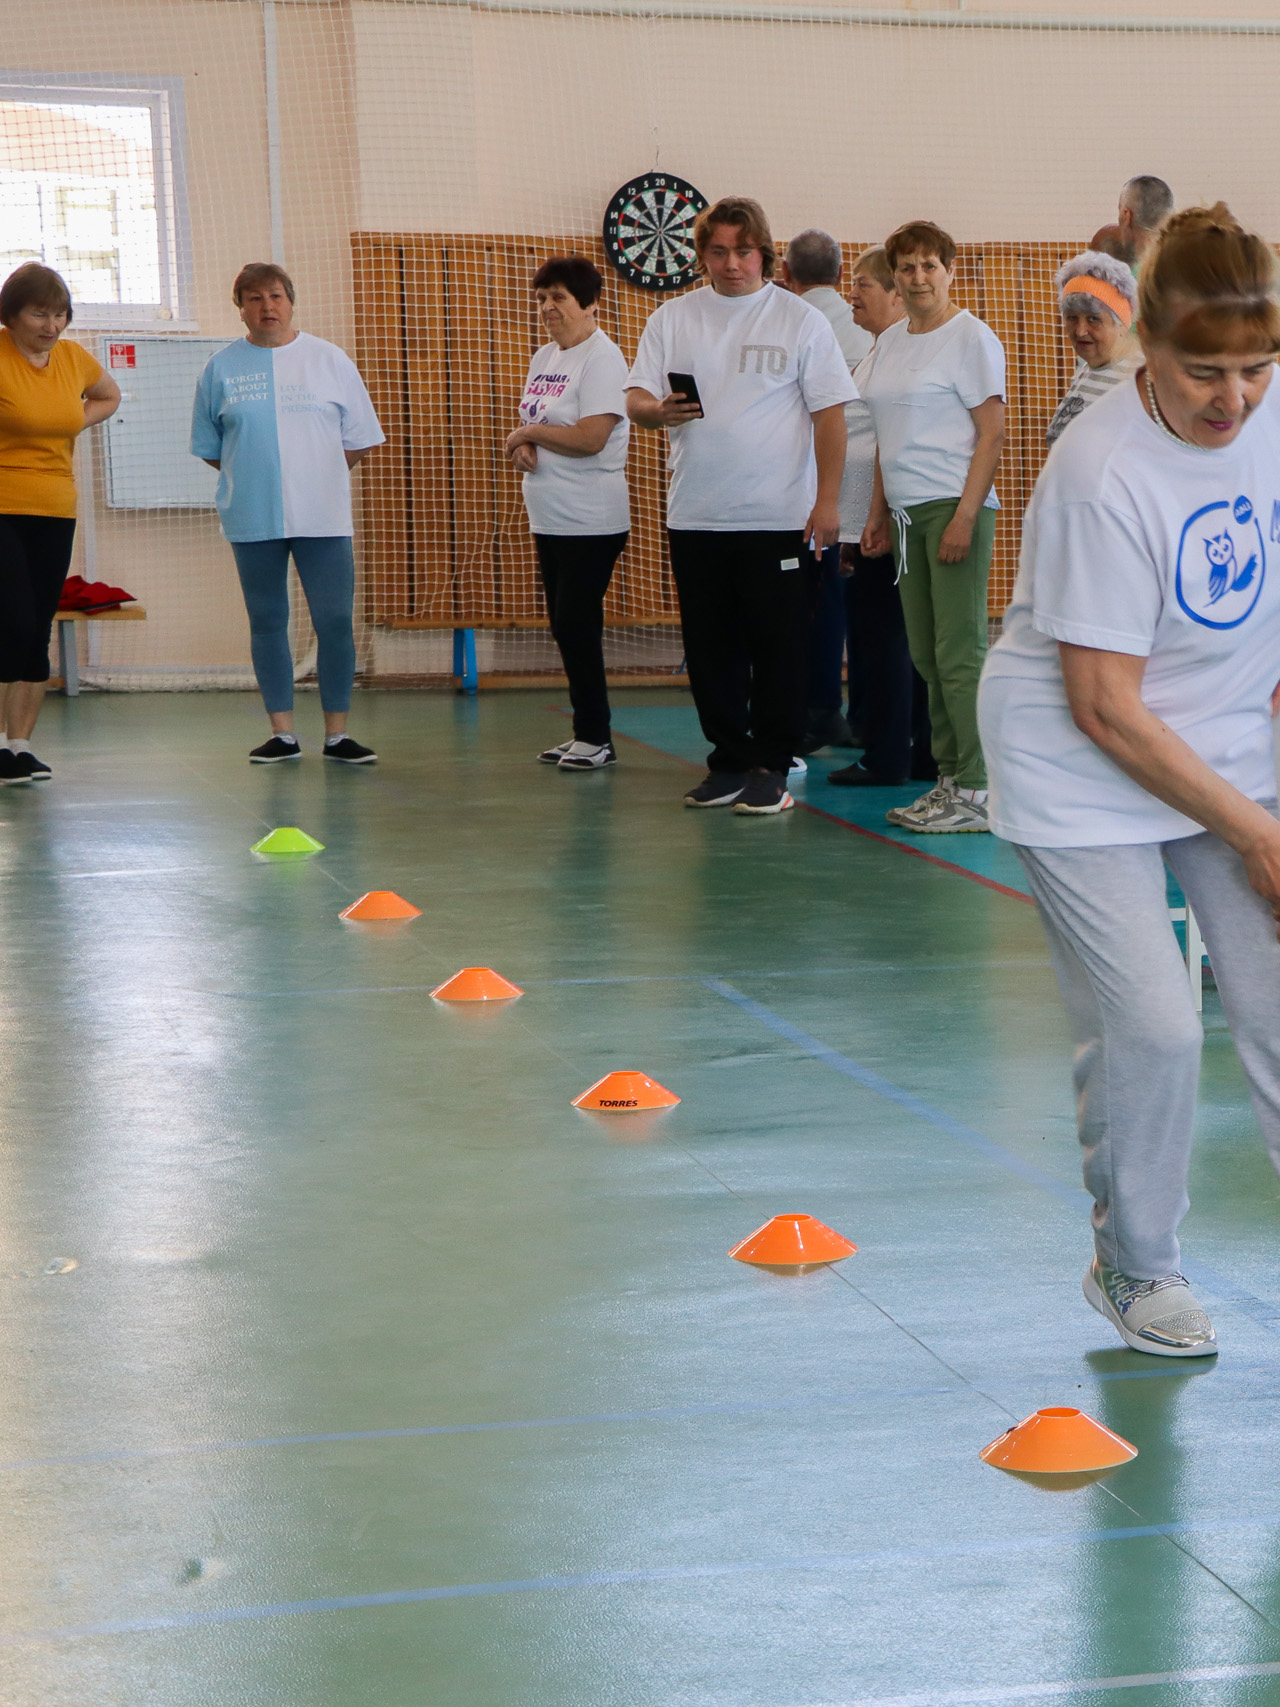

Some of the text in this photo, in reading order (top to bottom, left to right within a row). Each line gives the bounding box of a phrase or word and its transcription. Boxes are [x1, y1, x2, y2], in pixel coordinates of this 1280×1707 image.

[655, 178, 666, 186] 20
[627, 187, 637, 195] 12
[685, 190, 694, 198] 18
[610, 211, 619, 219] 14
[618, 255, 627, 264] 16
[641, 276, 651, 284] 19
[672, 276, 681, 284] 17
[738, 345, 788, 376] ГТО
[225, 372, 268, 385] FORGET
[231, 382, 269, 395] ABOUT
[599, 1099, 638, 1108] TORRES
